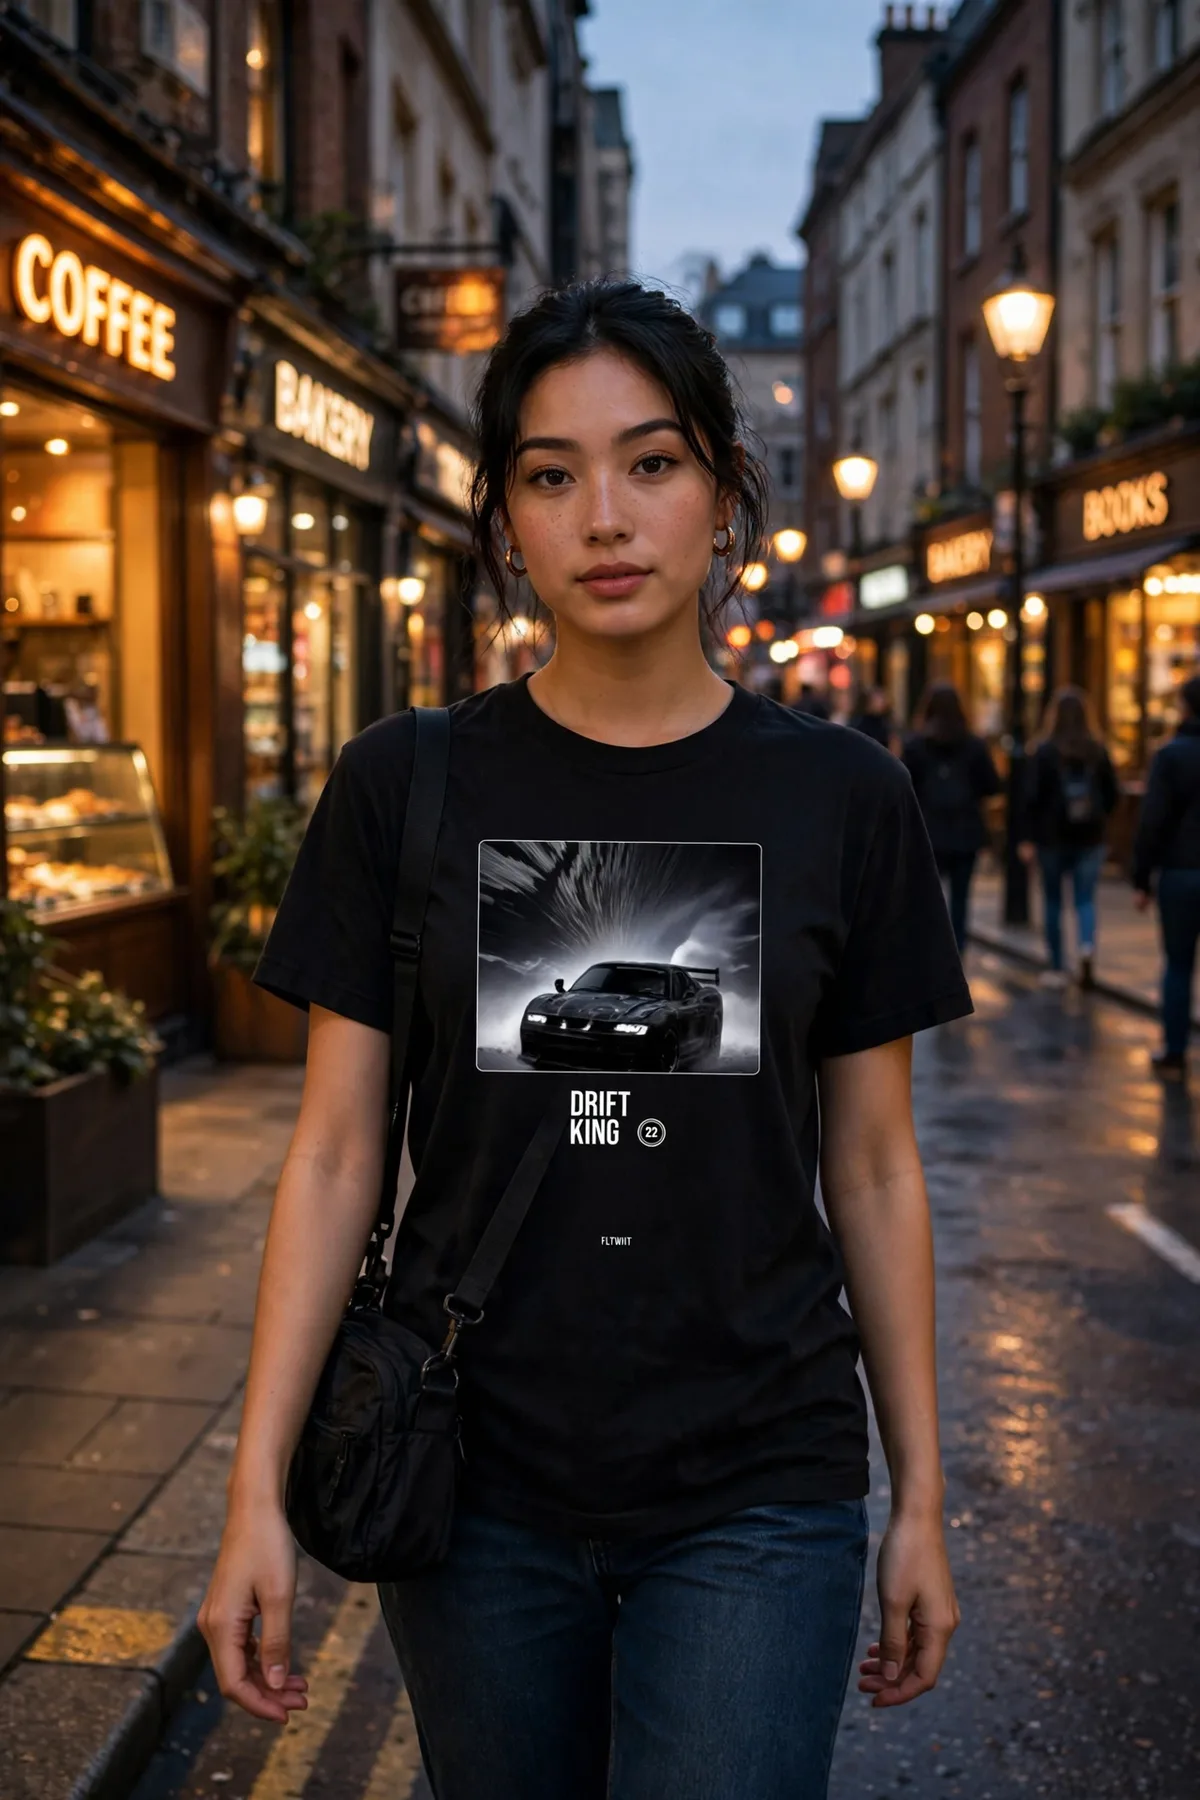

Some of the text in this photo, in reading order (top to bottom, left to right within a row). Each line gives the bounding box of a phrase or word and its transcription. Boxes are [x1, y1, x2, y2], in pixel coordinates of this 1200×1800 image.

[15, 233, 176, 381] COFFEE
[276, 360, 373, 471] BAKERY
[1083, 472, 1168, 541] BOOKS
[571, 1090, 631, 1117] DRIFT
[570, 1119, 620, 1145] KING
[645, 1126, 658, 1138] 22
